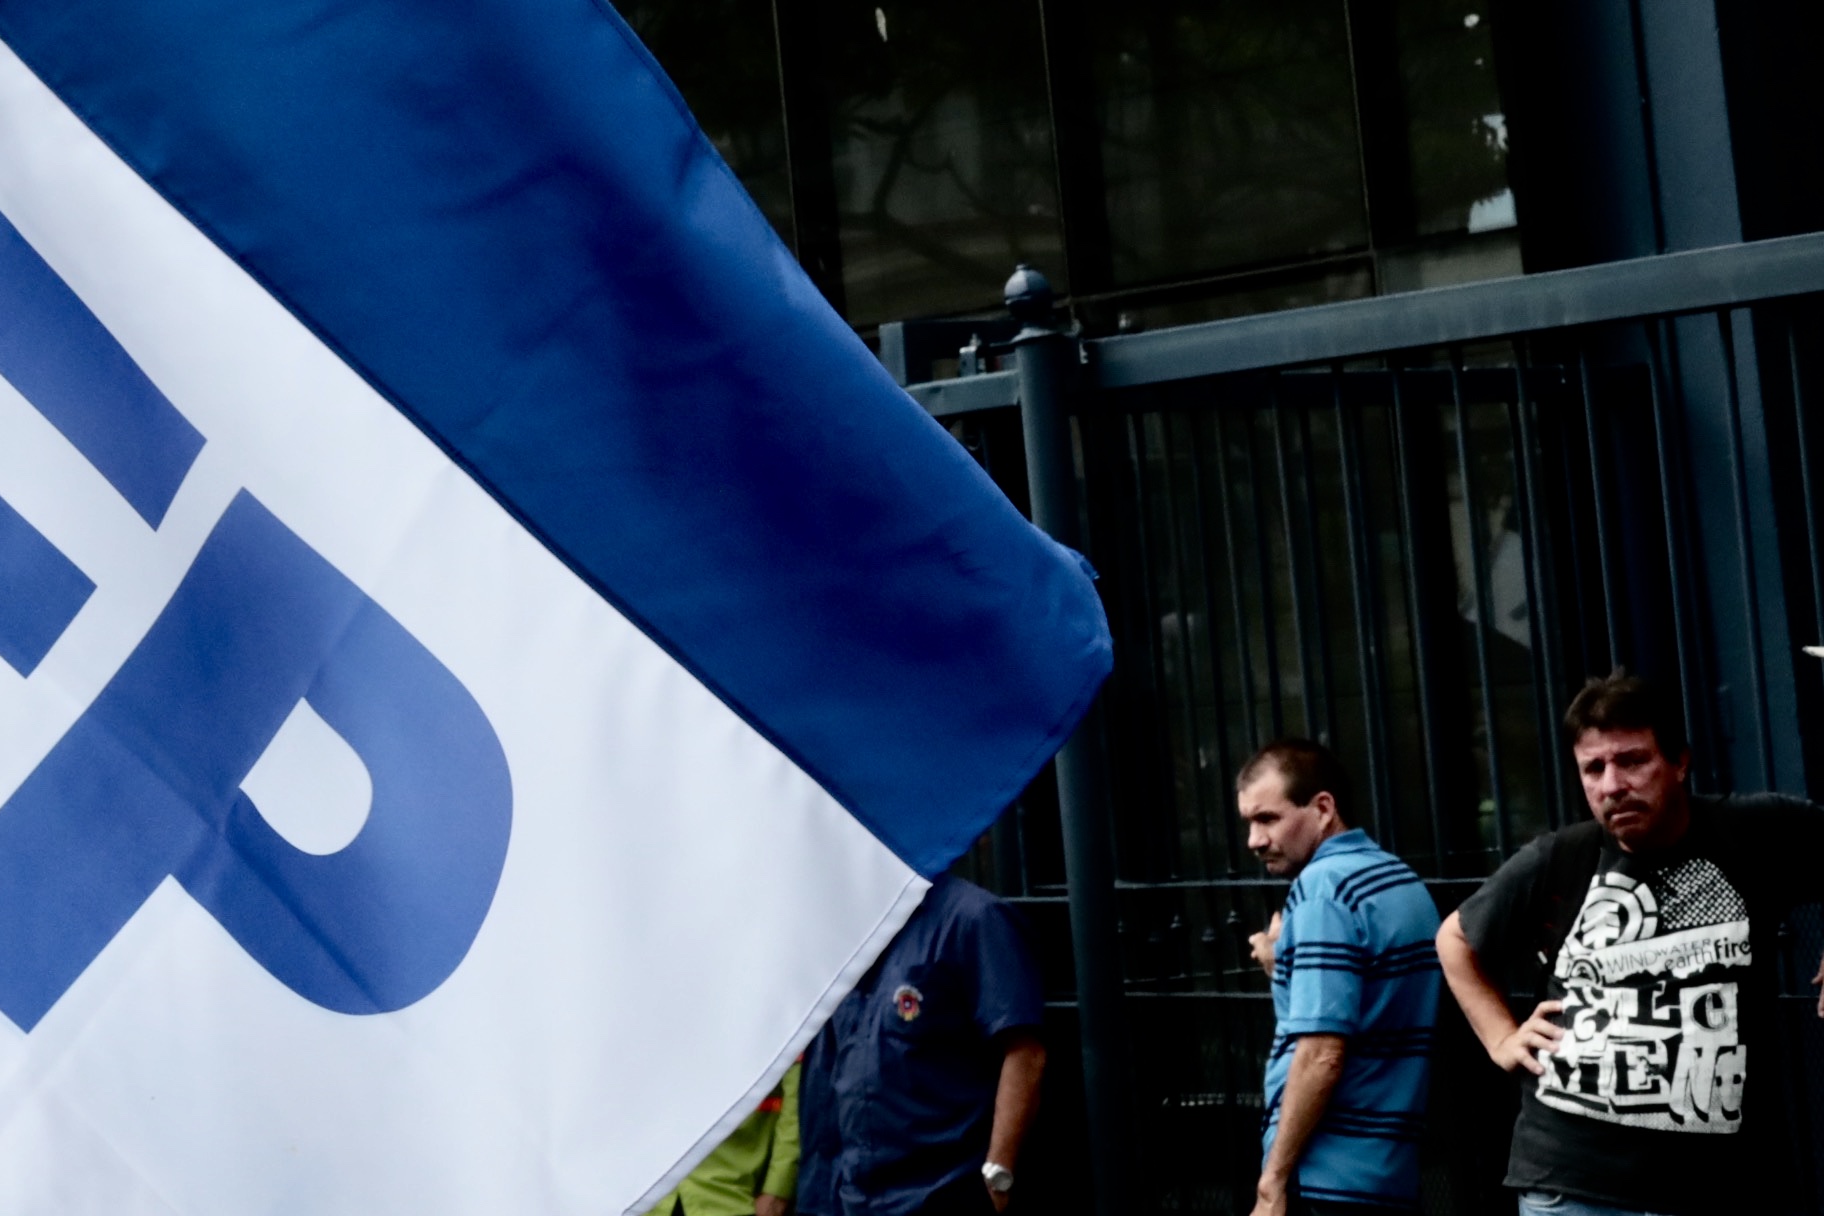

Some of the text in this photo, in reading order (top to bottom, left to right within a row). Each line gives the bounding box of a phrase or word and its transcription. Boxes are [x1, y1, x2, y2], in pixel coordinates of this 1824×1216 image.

[1605, 937, 1751, 975] WIND WATER earth fire
